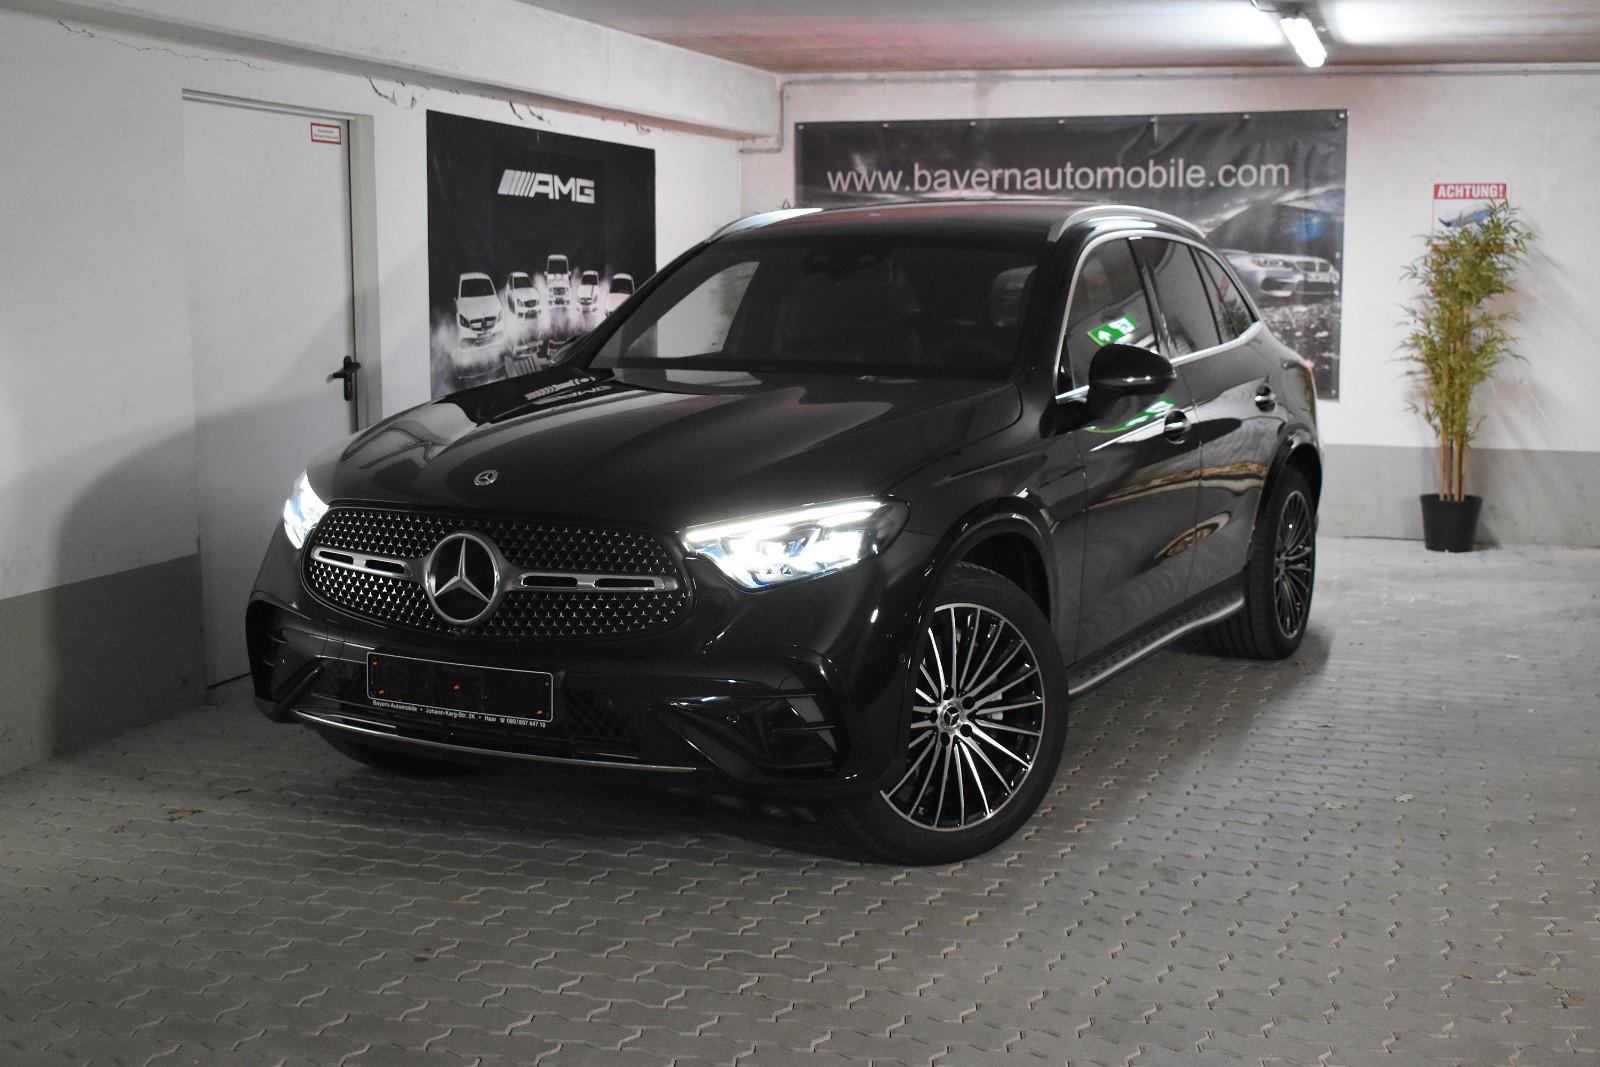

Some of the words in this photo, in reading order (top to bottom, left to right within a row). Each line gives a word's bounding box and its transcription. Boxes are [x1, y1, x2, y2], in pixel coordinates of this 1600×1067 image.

[528, 172, 595, 204] AMG
[827, 158, 1290, 195] www.bayernautomobile.com
[1437, 184, 1504, 198] ACHTUNG!
